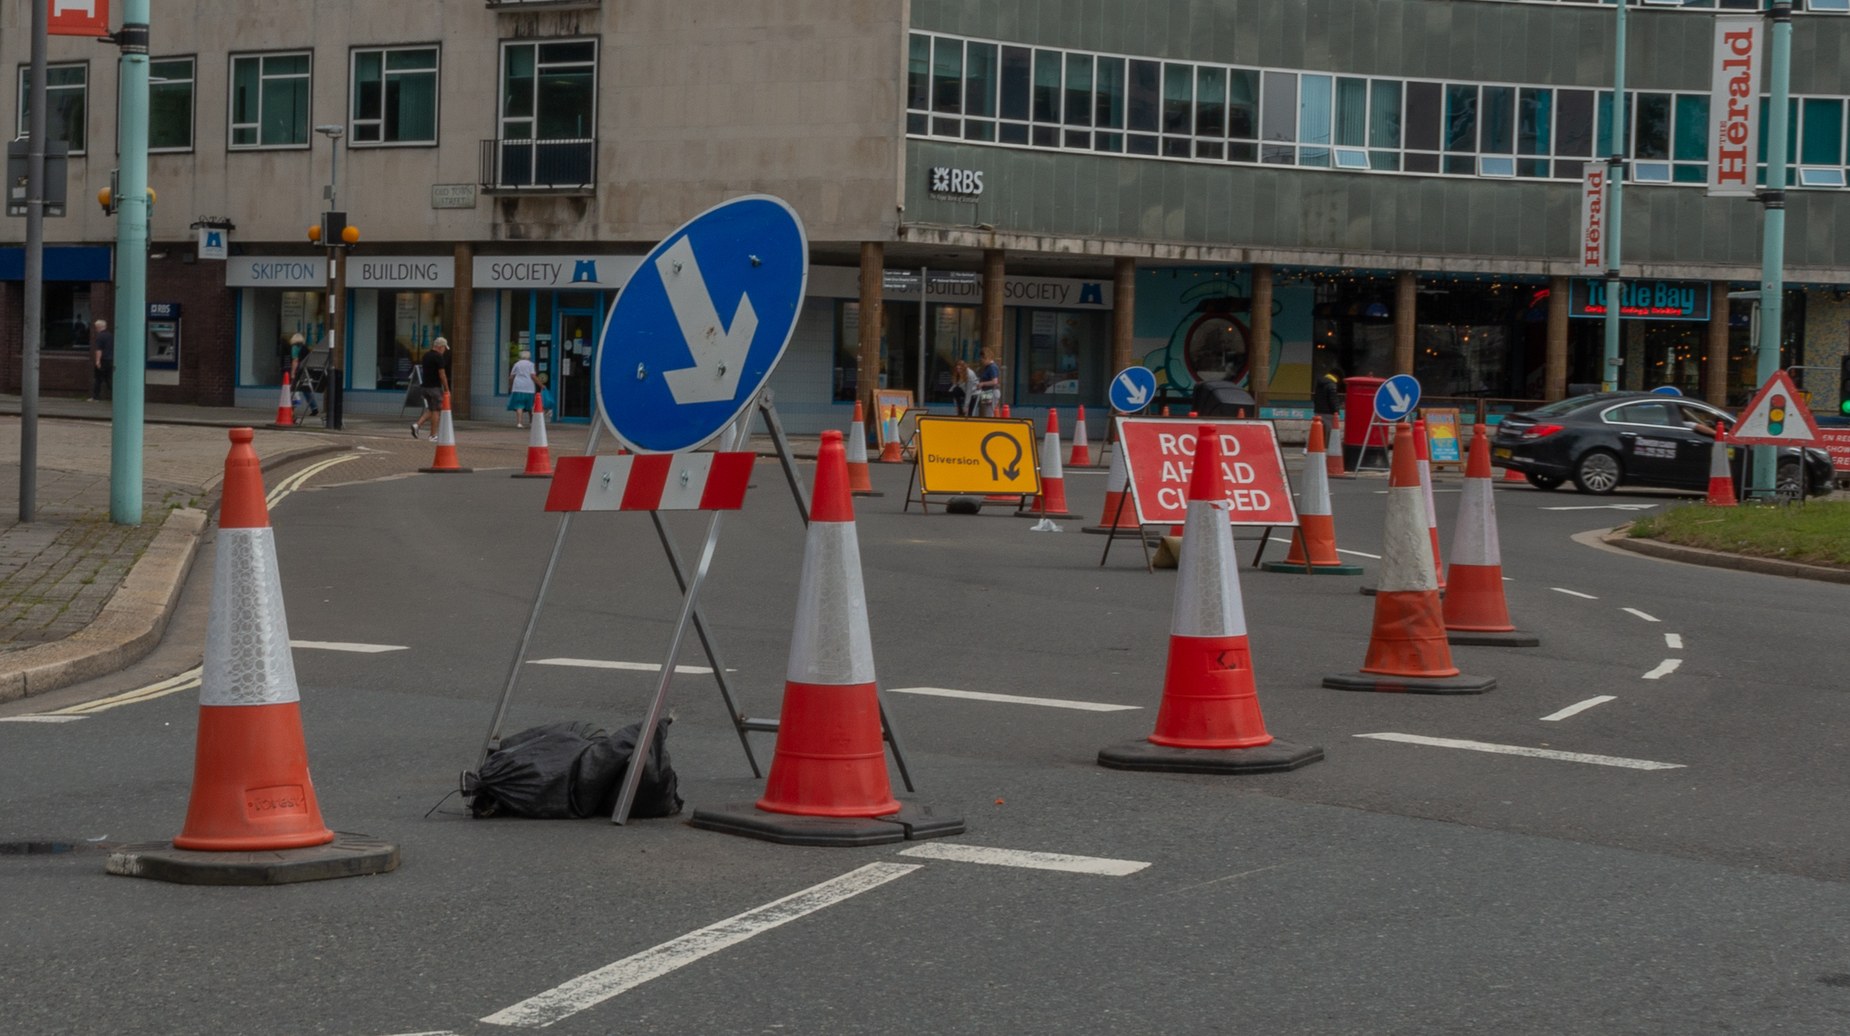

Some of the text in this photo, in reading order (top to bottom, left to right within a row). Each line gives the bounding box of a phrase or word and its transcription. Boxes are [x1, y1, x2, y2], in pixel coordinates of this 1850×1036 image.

[1718, 28, 1753, 185] Herald
[1719, 121, 1728, 146] THE
[951, 168, 983, 194] RBS
[1585, 170, 1603, 267] Herald
[251, 262, 562, 285] SKIPTON BUILDING SOCIETY
[1004, 281, 1070, 304] SOCIETY
[1587, 280, 1695, 315] Tutle Bay
[157, 304, 171, 313] RBS
[1159, 433, 1241, 457] ROD
[928, 454, 980, 466] Diversion
[1161, 461, 1256, 484] AHAD
[1157, 487, 1272, 511] CLSED
